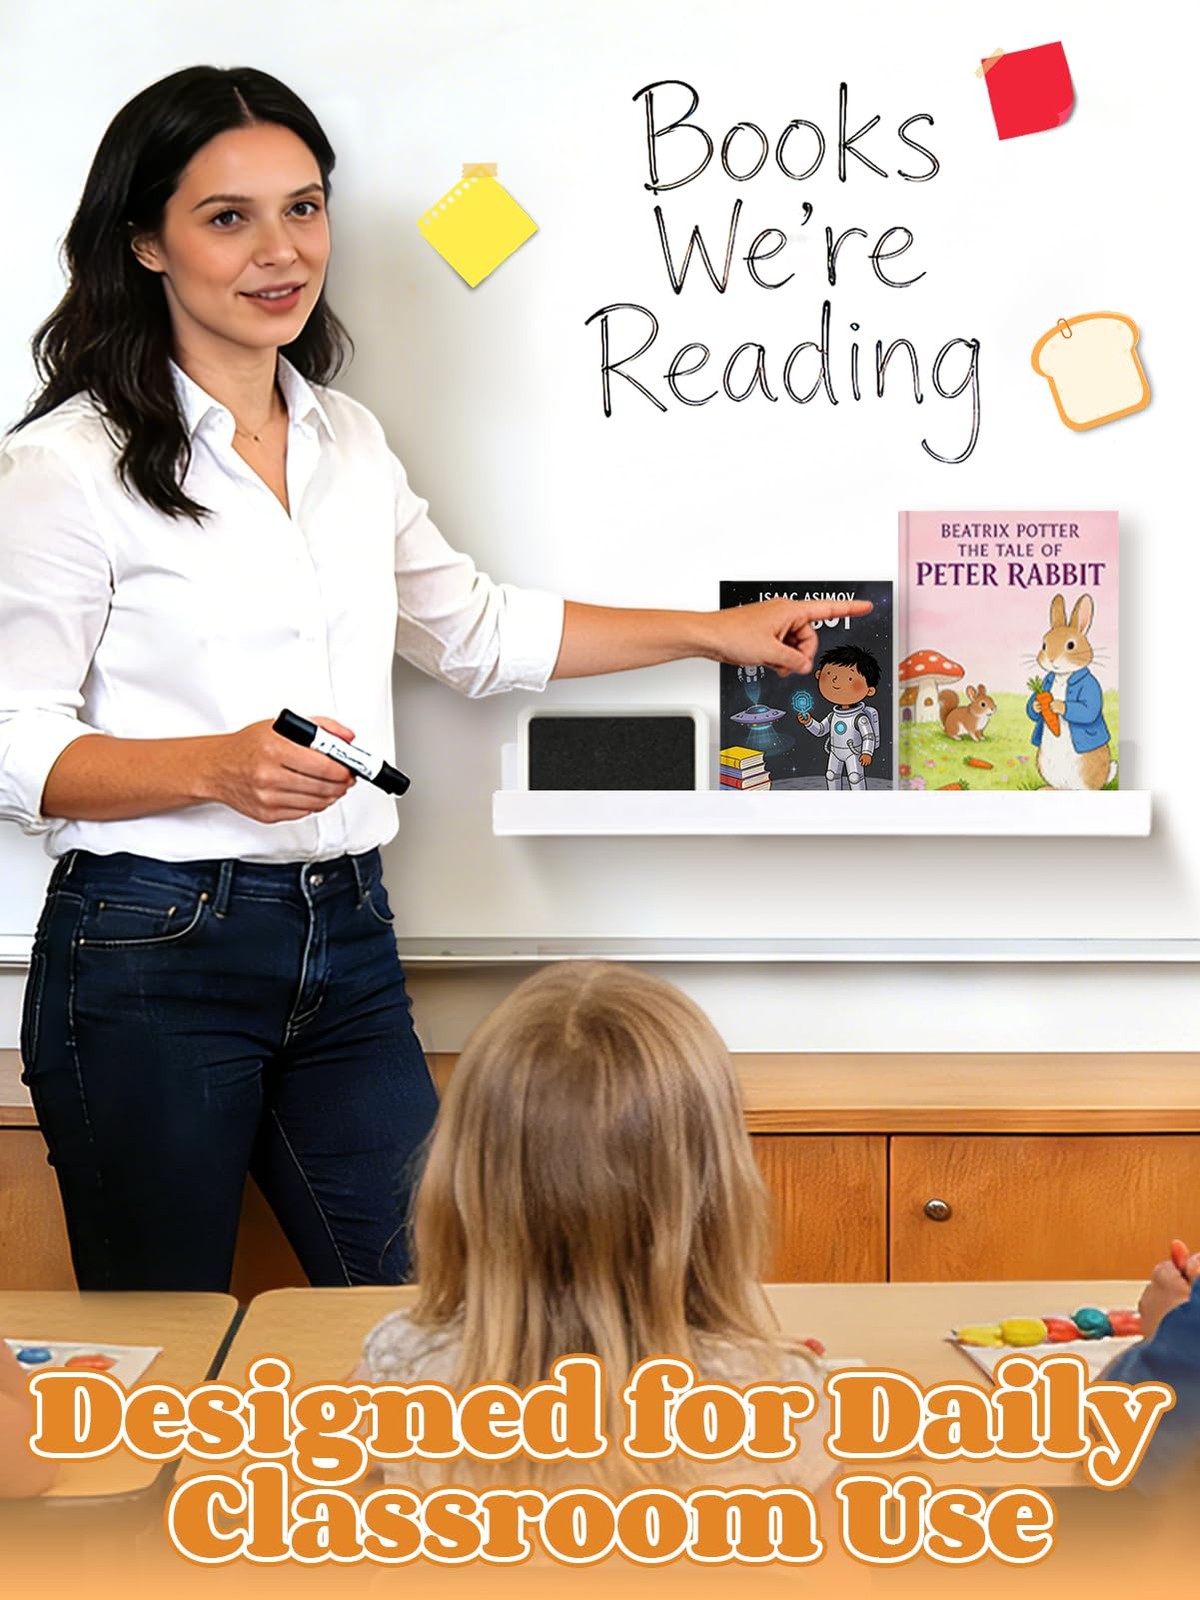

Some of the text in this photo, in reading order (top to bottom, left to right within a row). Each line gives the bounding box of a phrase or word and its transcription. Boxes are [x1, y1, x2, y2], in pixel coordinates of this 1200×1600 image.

[632, 79, 941, 195] Books
[654, 199, 927, 295] We're
[584, 300, 981, 464] Reading
[941, 523, 1080, 539] BEATRIX POTTER
[957, 543, 1062, 557] THE TALE OF
[916, 562, 1106, 589] PETER RABBIT
